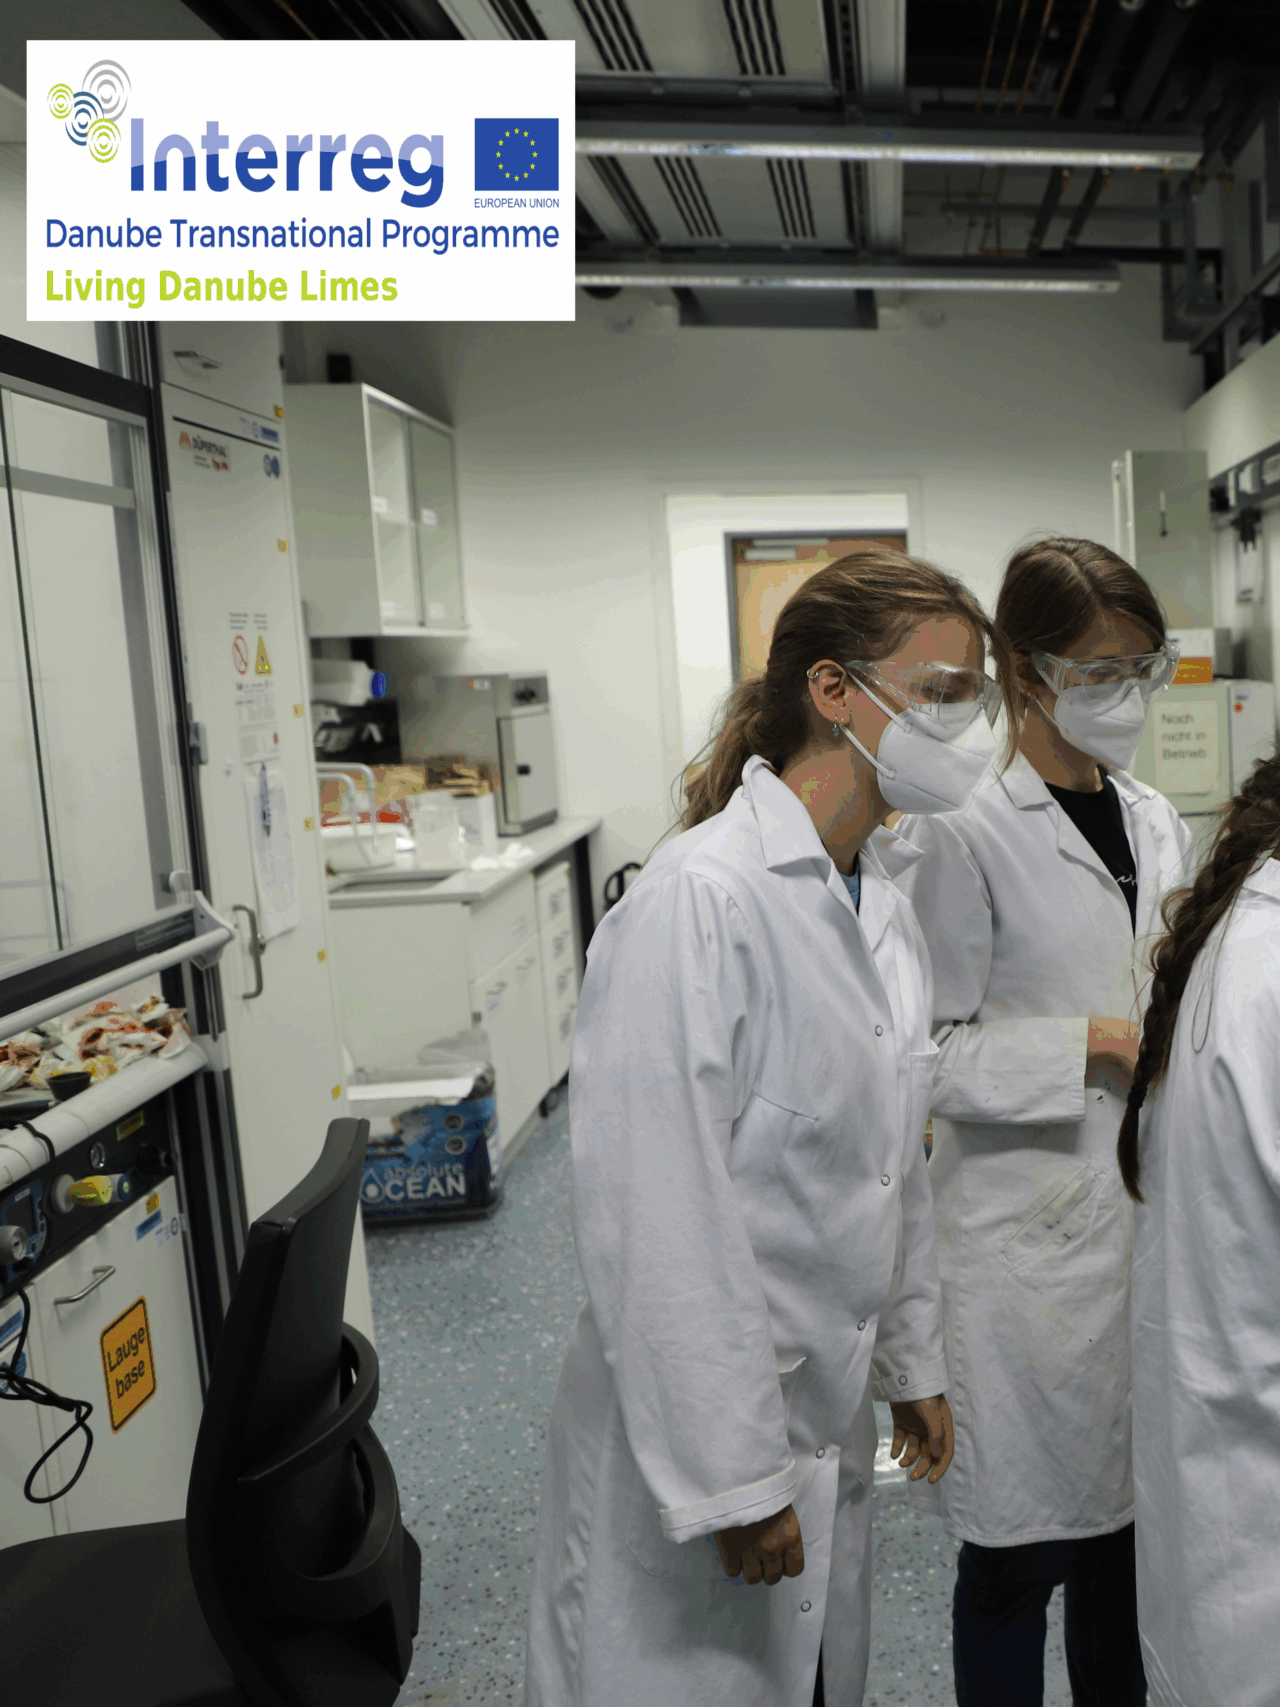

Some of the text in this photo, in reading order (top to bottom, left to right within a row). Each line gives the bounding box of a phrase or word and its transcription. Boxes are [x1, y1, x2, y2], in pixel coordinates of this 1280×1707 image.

[1161, 714, 1194, 725] Noch
[1161, 732, 1207, 742] nicht in
[1162, 748, 1207, 760] Betrieb
[383, 1162, 463, 1181] absolute
[107, 1326, 145, 1373] Lauge
[115, 1359, 145, 1399] base
